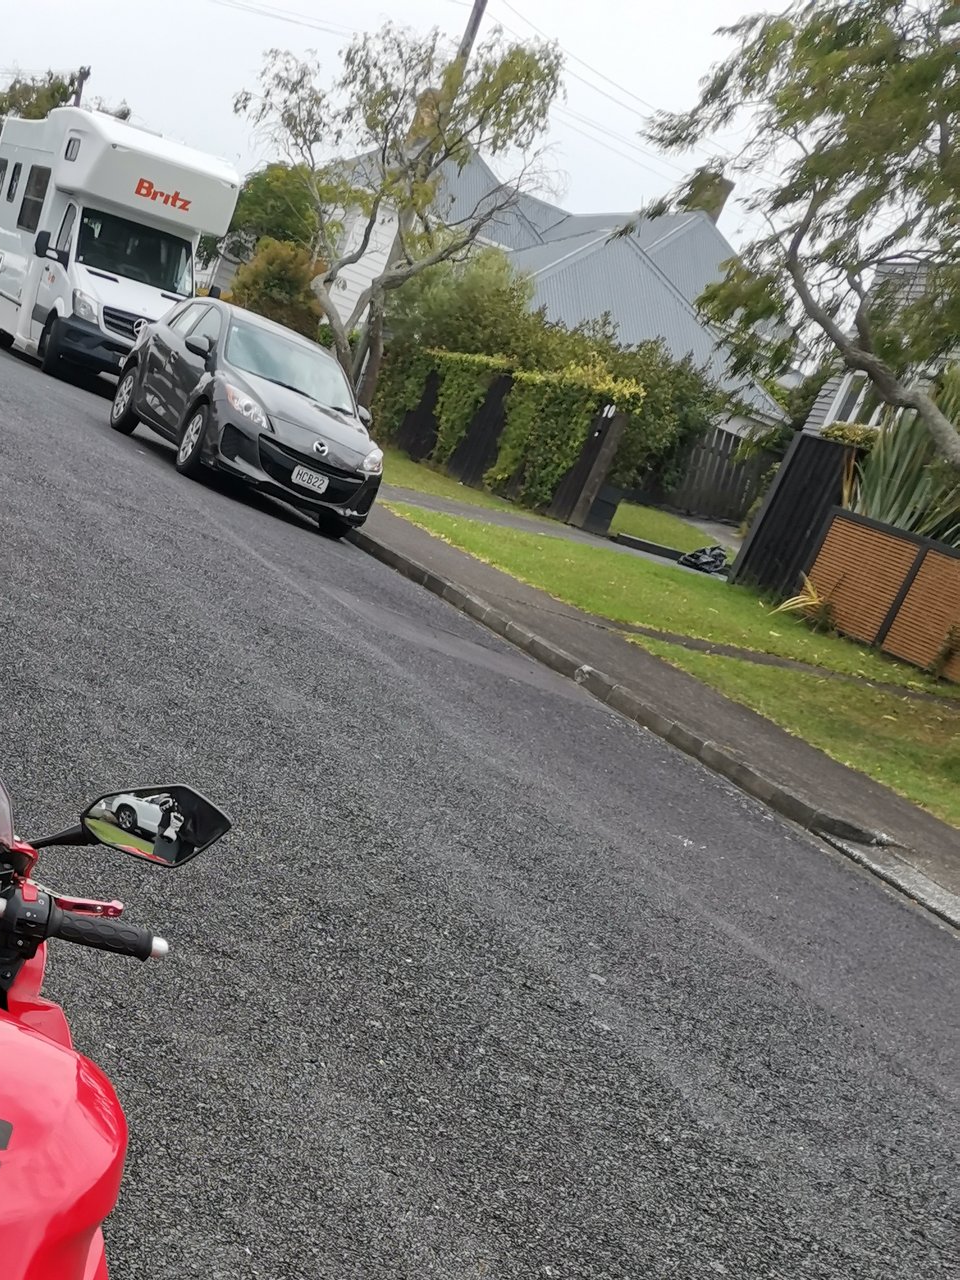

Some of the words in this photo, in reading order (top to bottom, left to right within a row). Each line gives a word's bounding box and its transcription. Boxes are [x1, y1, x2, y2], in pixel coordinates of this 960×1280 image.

[134, 177, 192, 212] Britz
[602, 404, 616, 418] 10
[295, 469, 325, 490] HCB22
